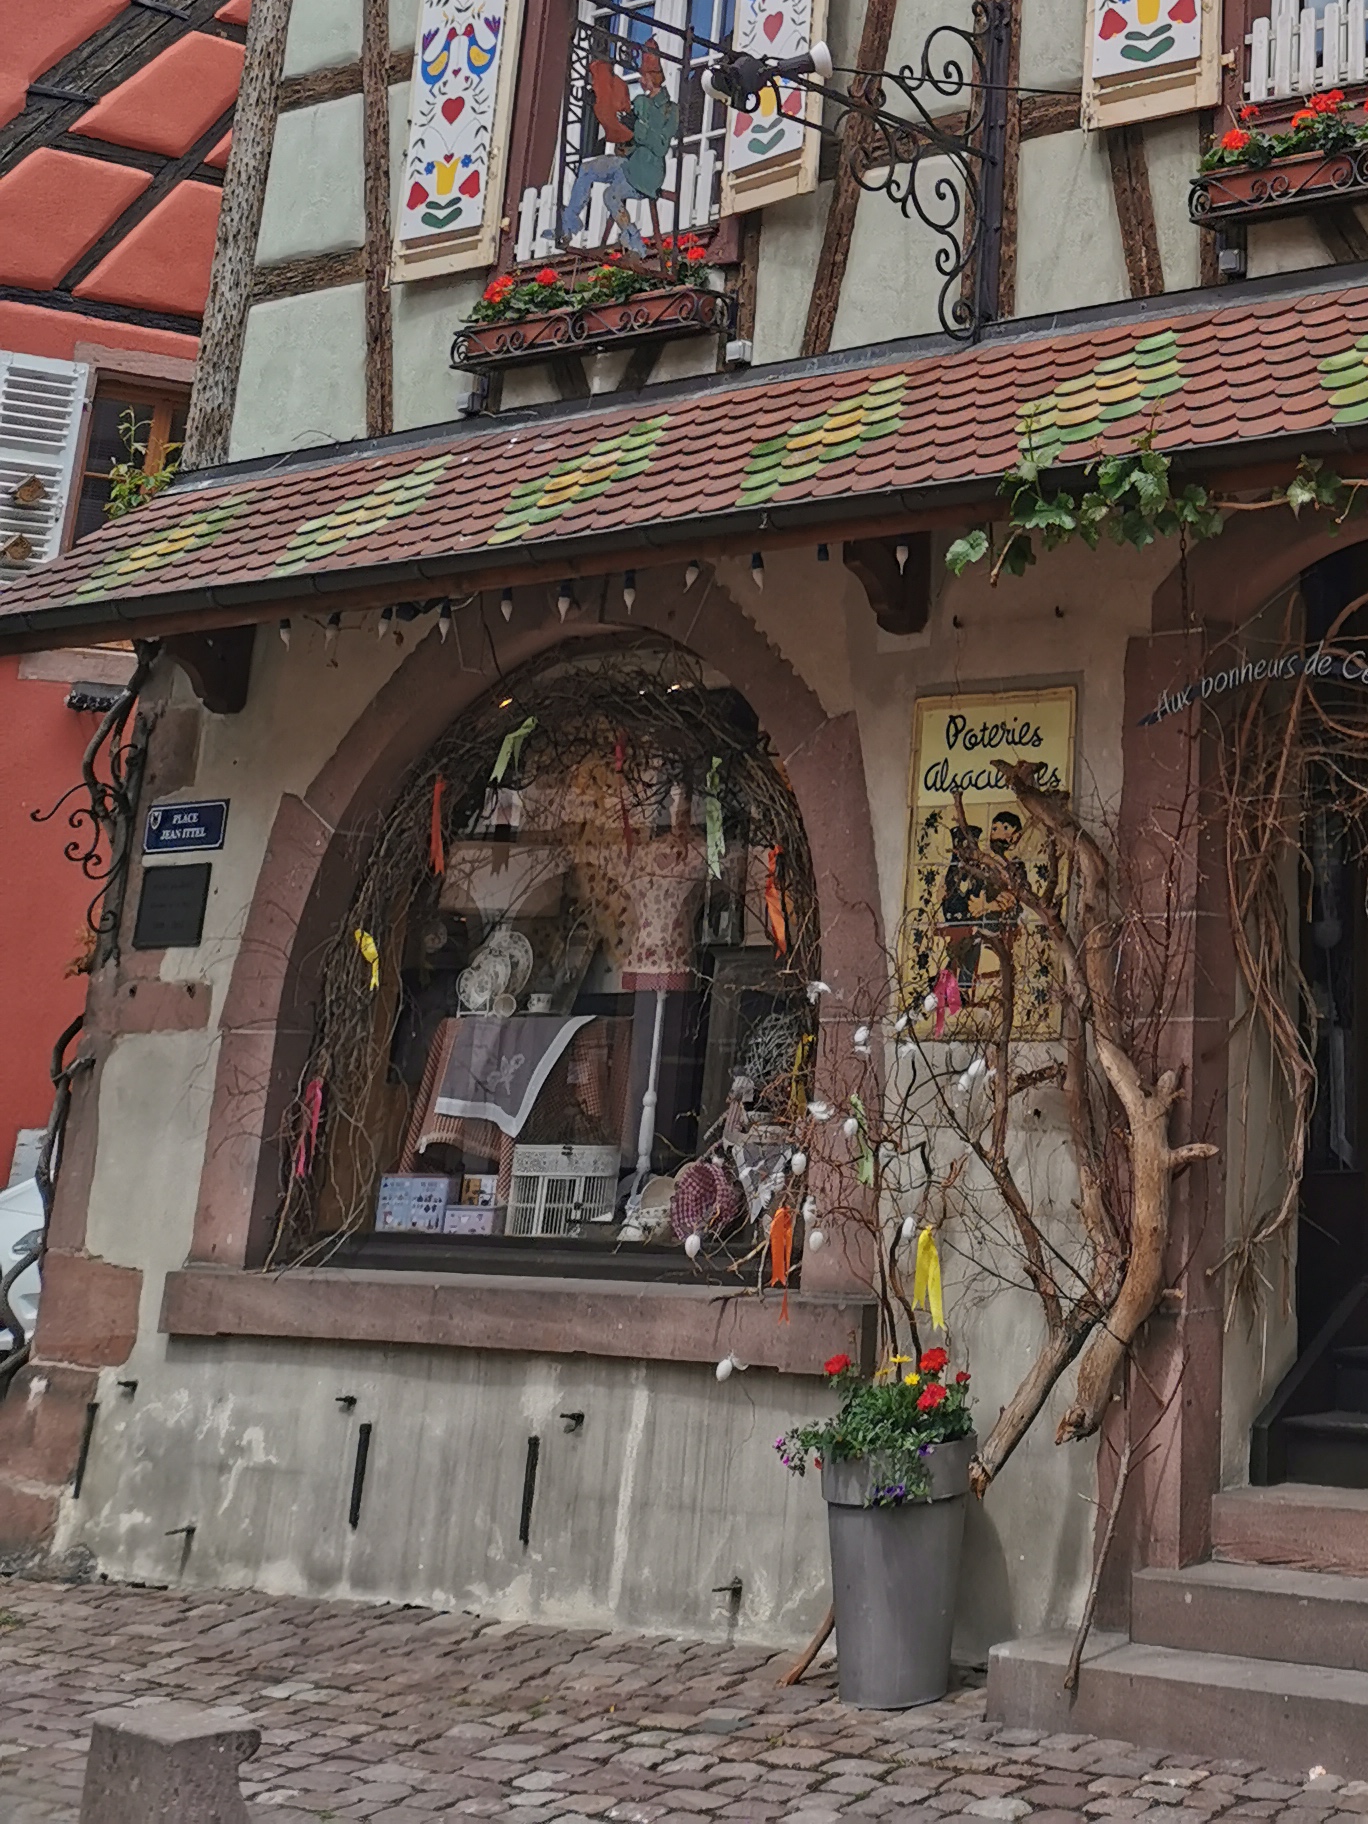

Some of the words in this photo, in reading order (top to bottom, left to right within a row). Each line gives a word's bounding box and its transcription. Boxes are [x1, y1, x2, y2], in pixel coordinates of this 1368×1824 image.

[1156, 685, 1193, 721] Aux
[1304, 640, 1333, 676] de
[945, 714, 1044, 751] Poteries
[924, 757, 1062, 793] Alsaciees
[160, 829, 181, 840] JEAN
[182, 827, 206, 838] ITTEL
[172, 813, 199, 825] PLACE
